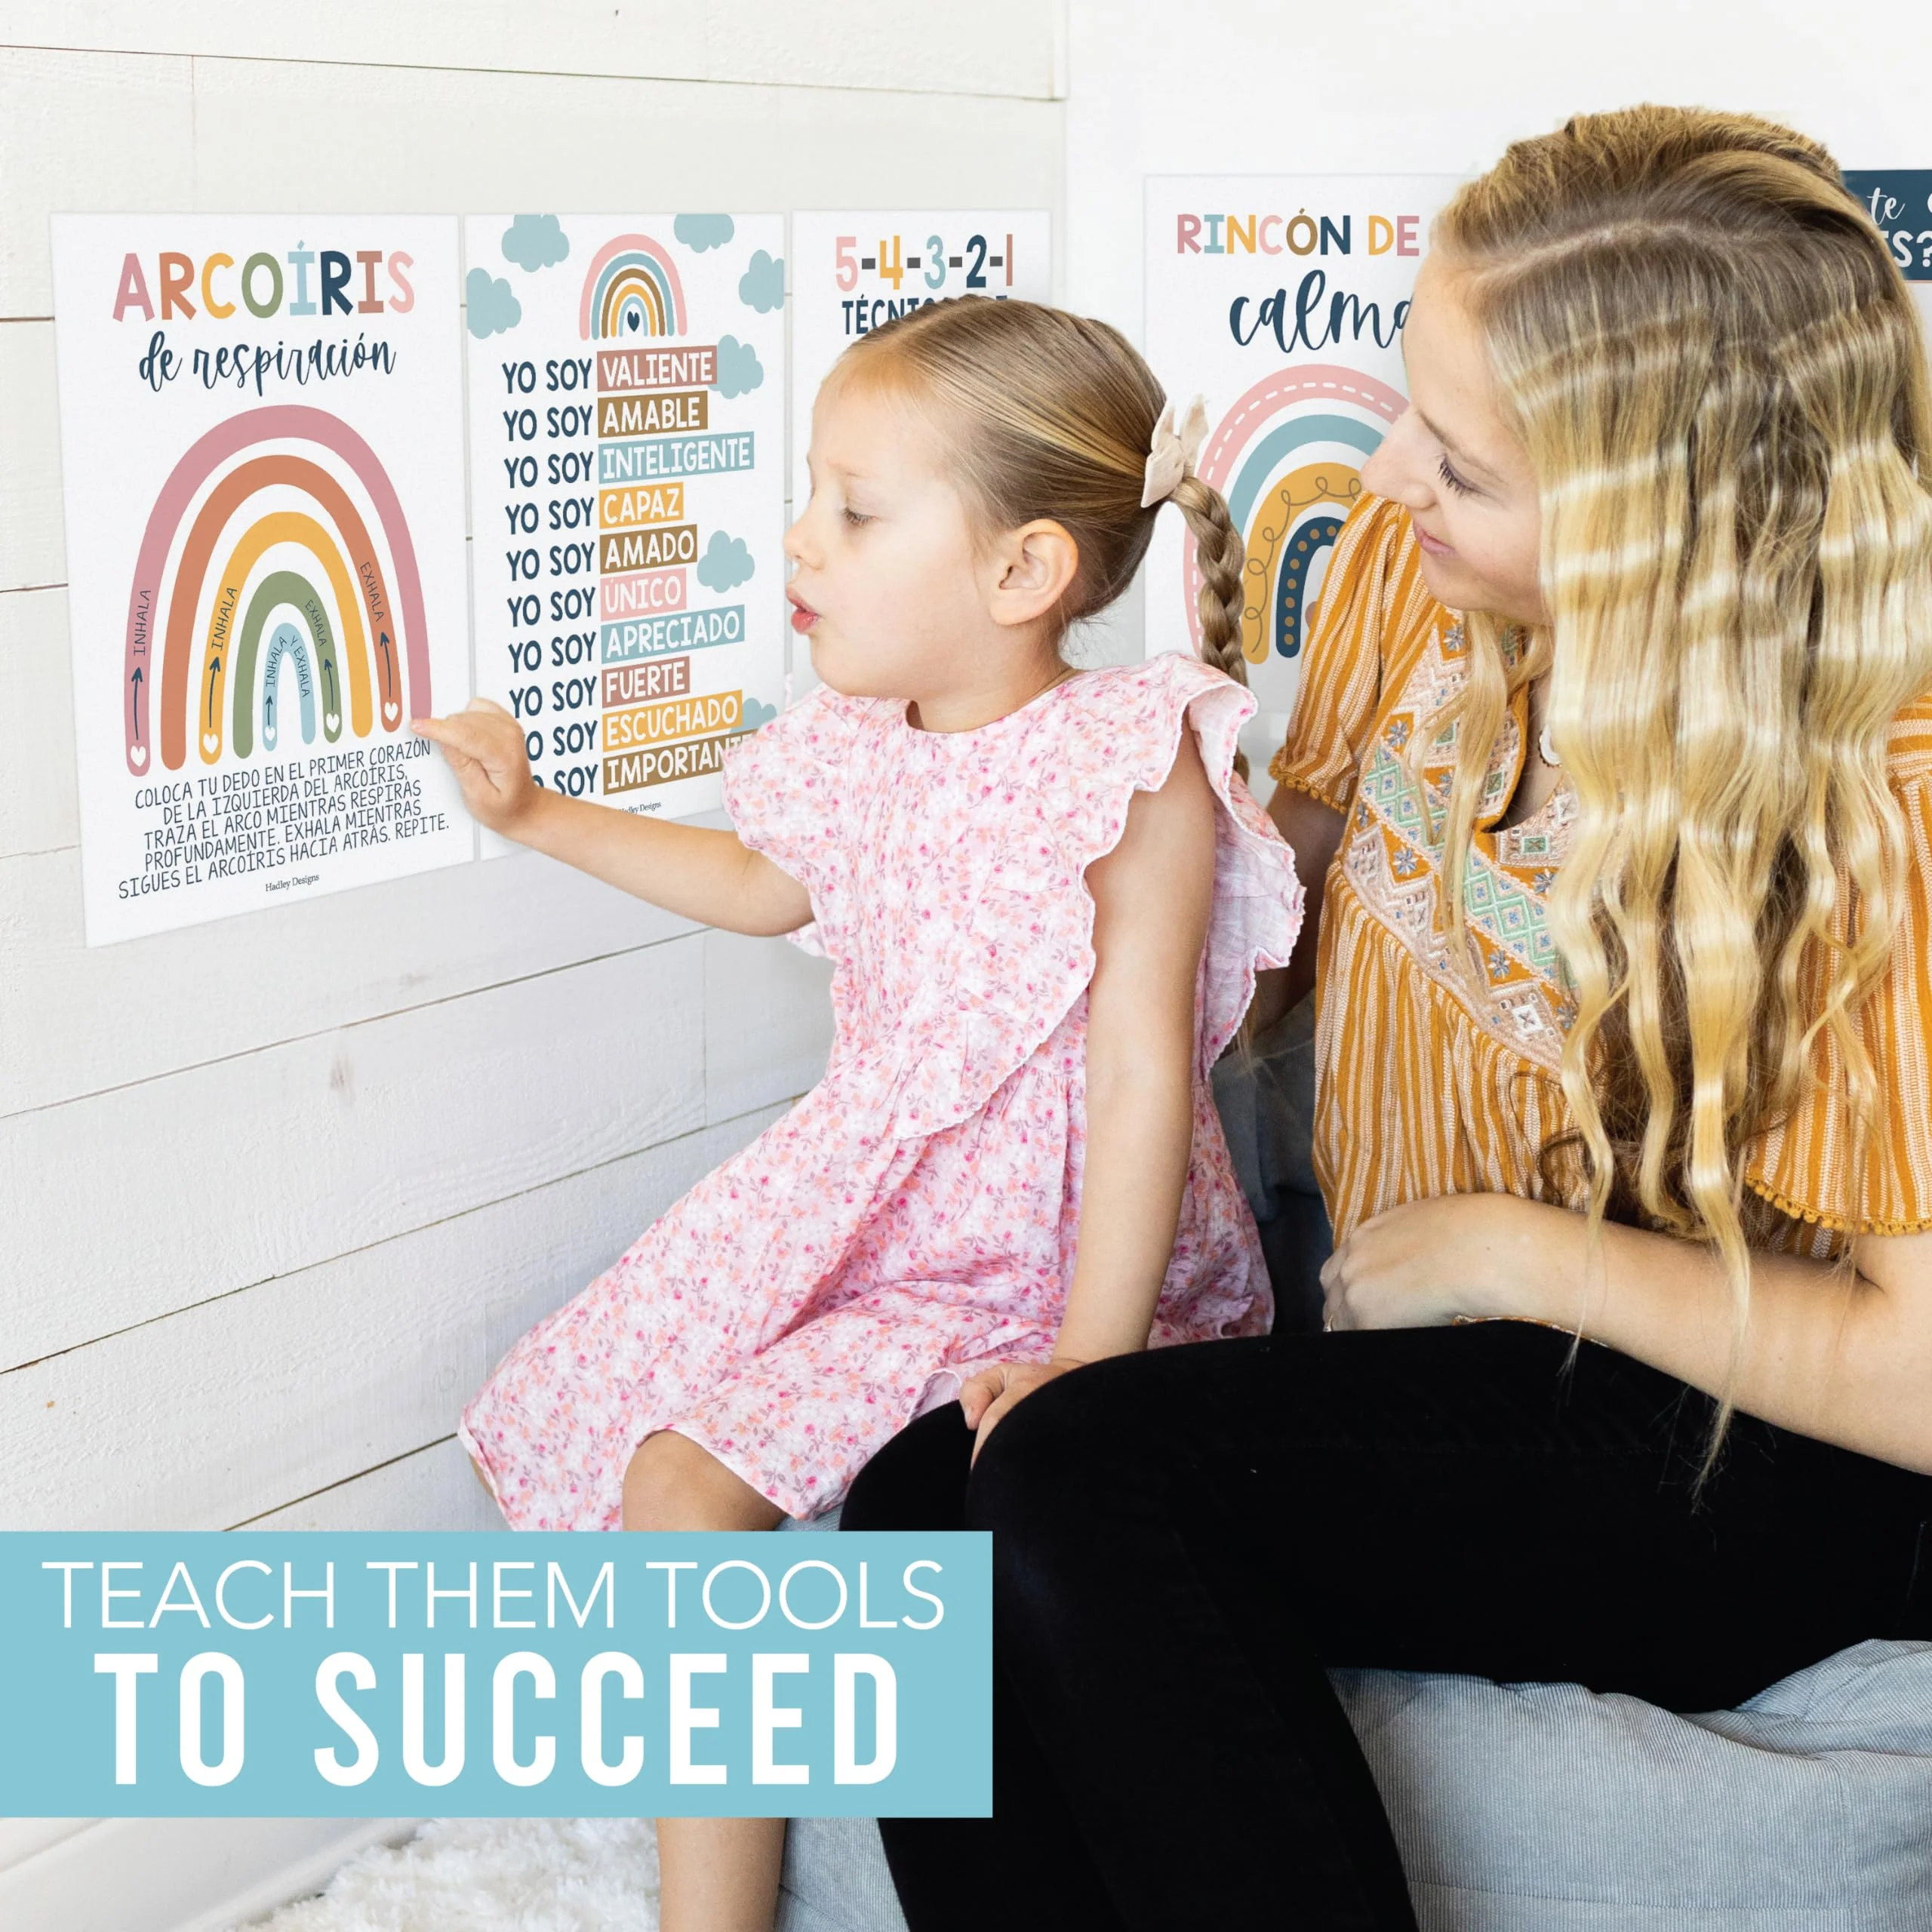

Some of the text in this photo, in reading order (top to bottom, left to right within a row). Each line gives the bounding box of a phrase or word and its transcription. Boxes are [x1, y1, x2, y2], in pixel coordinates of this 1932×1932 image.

[1177, 208, 1420, 257] RINCÓN DE
[1866, 187, 1906, 226] te
[1879, 230, 1932, 268] S?
[112, 239, 415, 322] ARCOÍRIS
[841, 294, 949, 334] TÉCN
[139, 331, 396, 397] de respiración
[502, 351, 713, 394] YO SOY VALIENTE
[503, 397, 700, 441] YO SOY AMABLE
[503, 437, 750, 489] YO SOY INTELIGENTE
[505, 488, 680, 535] YO SOY CAPAZ
[506, 530, 694, 581] YO SOY AMADO
[211, 587, 238, 651] INHALA
[360, 561, 384, 622] EXHALA
[506, 576, 681, 627] YO SOY ÚNICO
[134, 589, 151, 656] INHALA
[305, 599, 327, 646] EXHALA
[508, 610, 740, 673] YO SOY APRECIADO
[266, 635, 310, 697] INHALA Y EXHALA
[509, 661, 685, 718] YO SOY FUERTE
[524, 695, 738, 761] O SOY ESCUCHADO
[135, 737, 431, 808] COLOCA TU DEDO EN EL PRIMER CORAZÓN
[164, 764, 408, 825] DE LA IZQUIERDA DEL ARCOÍRIS,
[554, 734, 752, 797] SOY IMPORTAN
[144, 780, 422, 851] TRAZA EL ARCO MIENTRAS RESPIRAS
[145, 799, 422, 872] PROFUNDAMENTE. EXHALA MIENTRAS
[619, 801, 662, 815] dley Designs
[118, 813, 450, 899] SIGUES EL ARCOÍRIS HACIA ATRÁS. REPITE.
[265, 873, 320, 892] Hadley Designs
